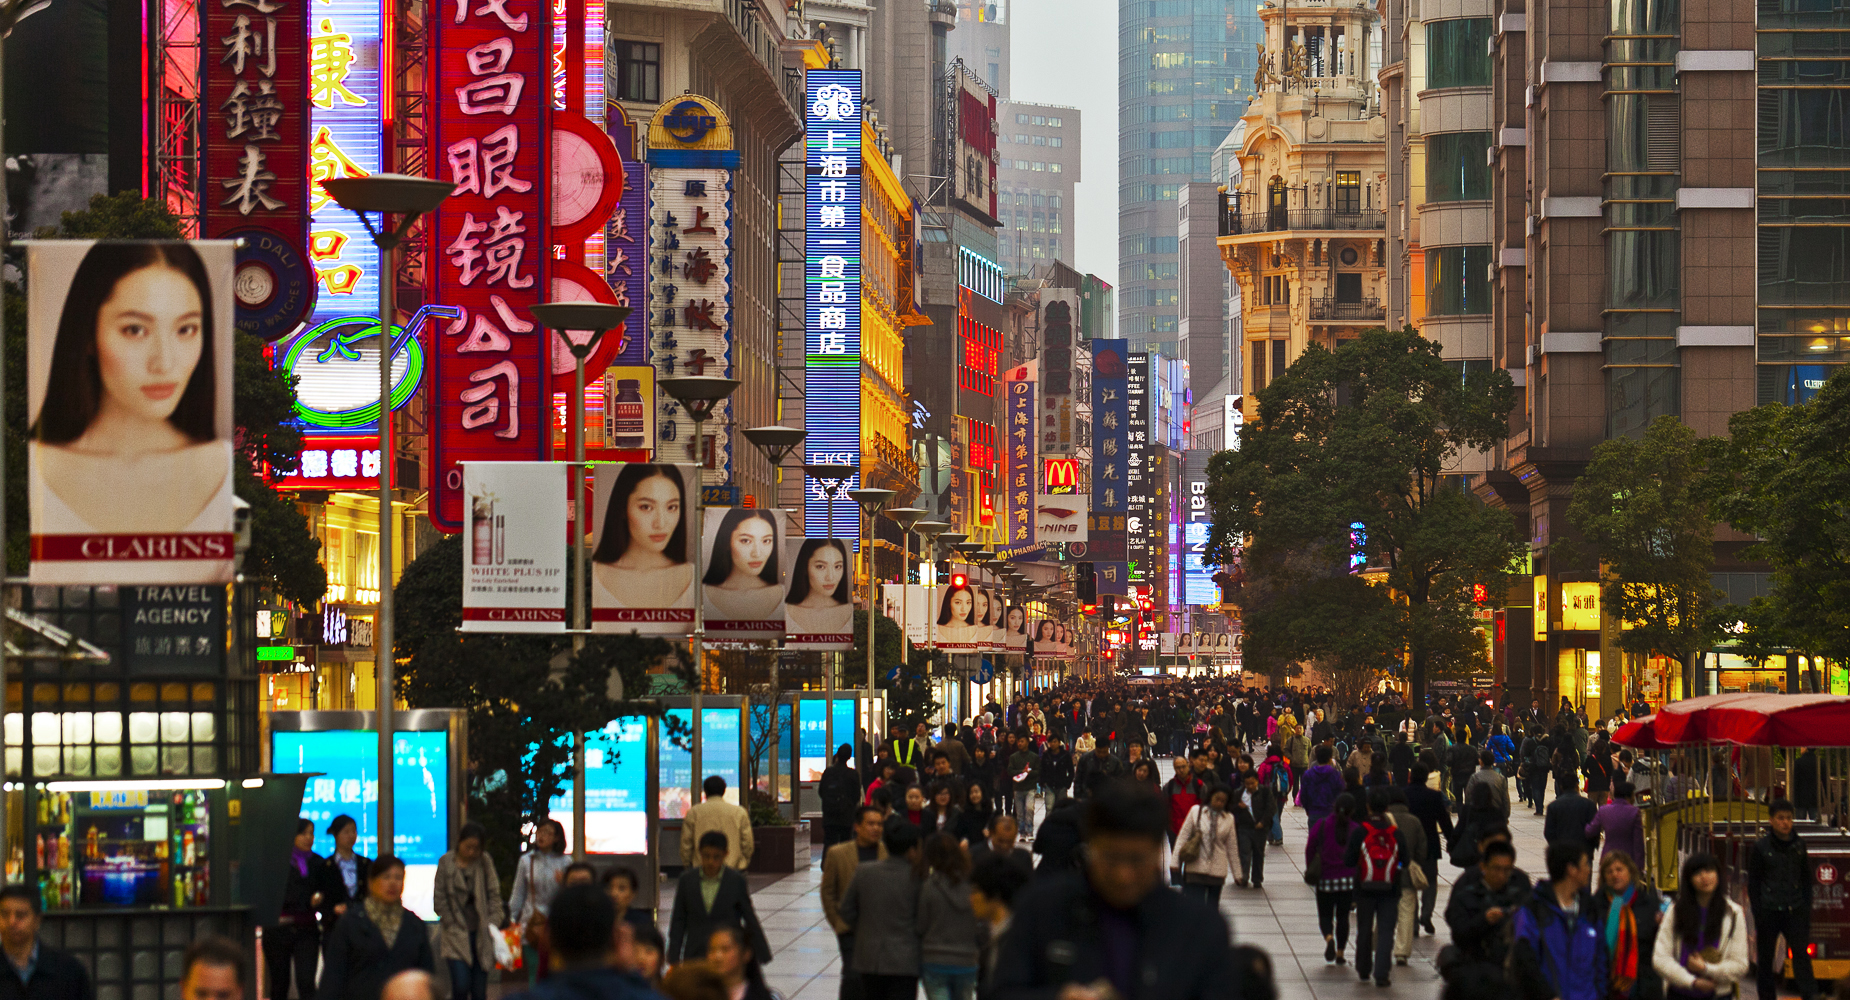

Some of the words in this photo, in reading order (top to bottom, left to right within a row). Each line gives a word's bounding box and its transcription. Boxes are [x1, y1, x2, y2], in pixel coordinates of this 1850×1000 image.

[219, 0, 289, 216] 利鐘表
[819, 129, 848, 355] 上海市第一食品商店
[259, 236, 297, 269] DALI
[264, 279, 301, 328] WATCHES
[81, 536, 226, 559] CLARINS
[1013, 540, 1048, 557] PHARMACY
[471, 567, 511, 577] WHITE
[513, 567, 542, 577] PLUS
[135, 585, 212, 603] TRAVEL
[134, 608, 212, 625] AGENCY
[488, 609, 562, 621] CLARINS
[617, 610, 692, 621] CLARINS
[724, 621, 784, 631] CLARINS
[801, 634, 852, 643] CLARINS
[257, 649, 290, 659] OLEX
